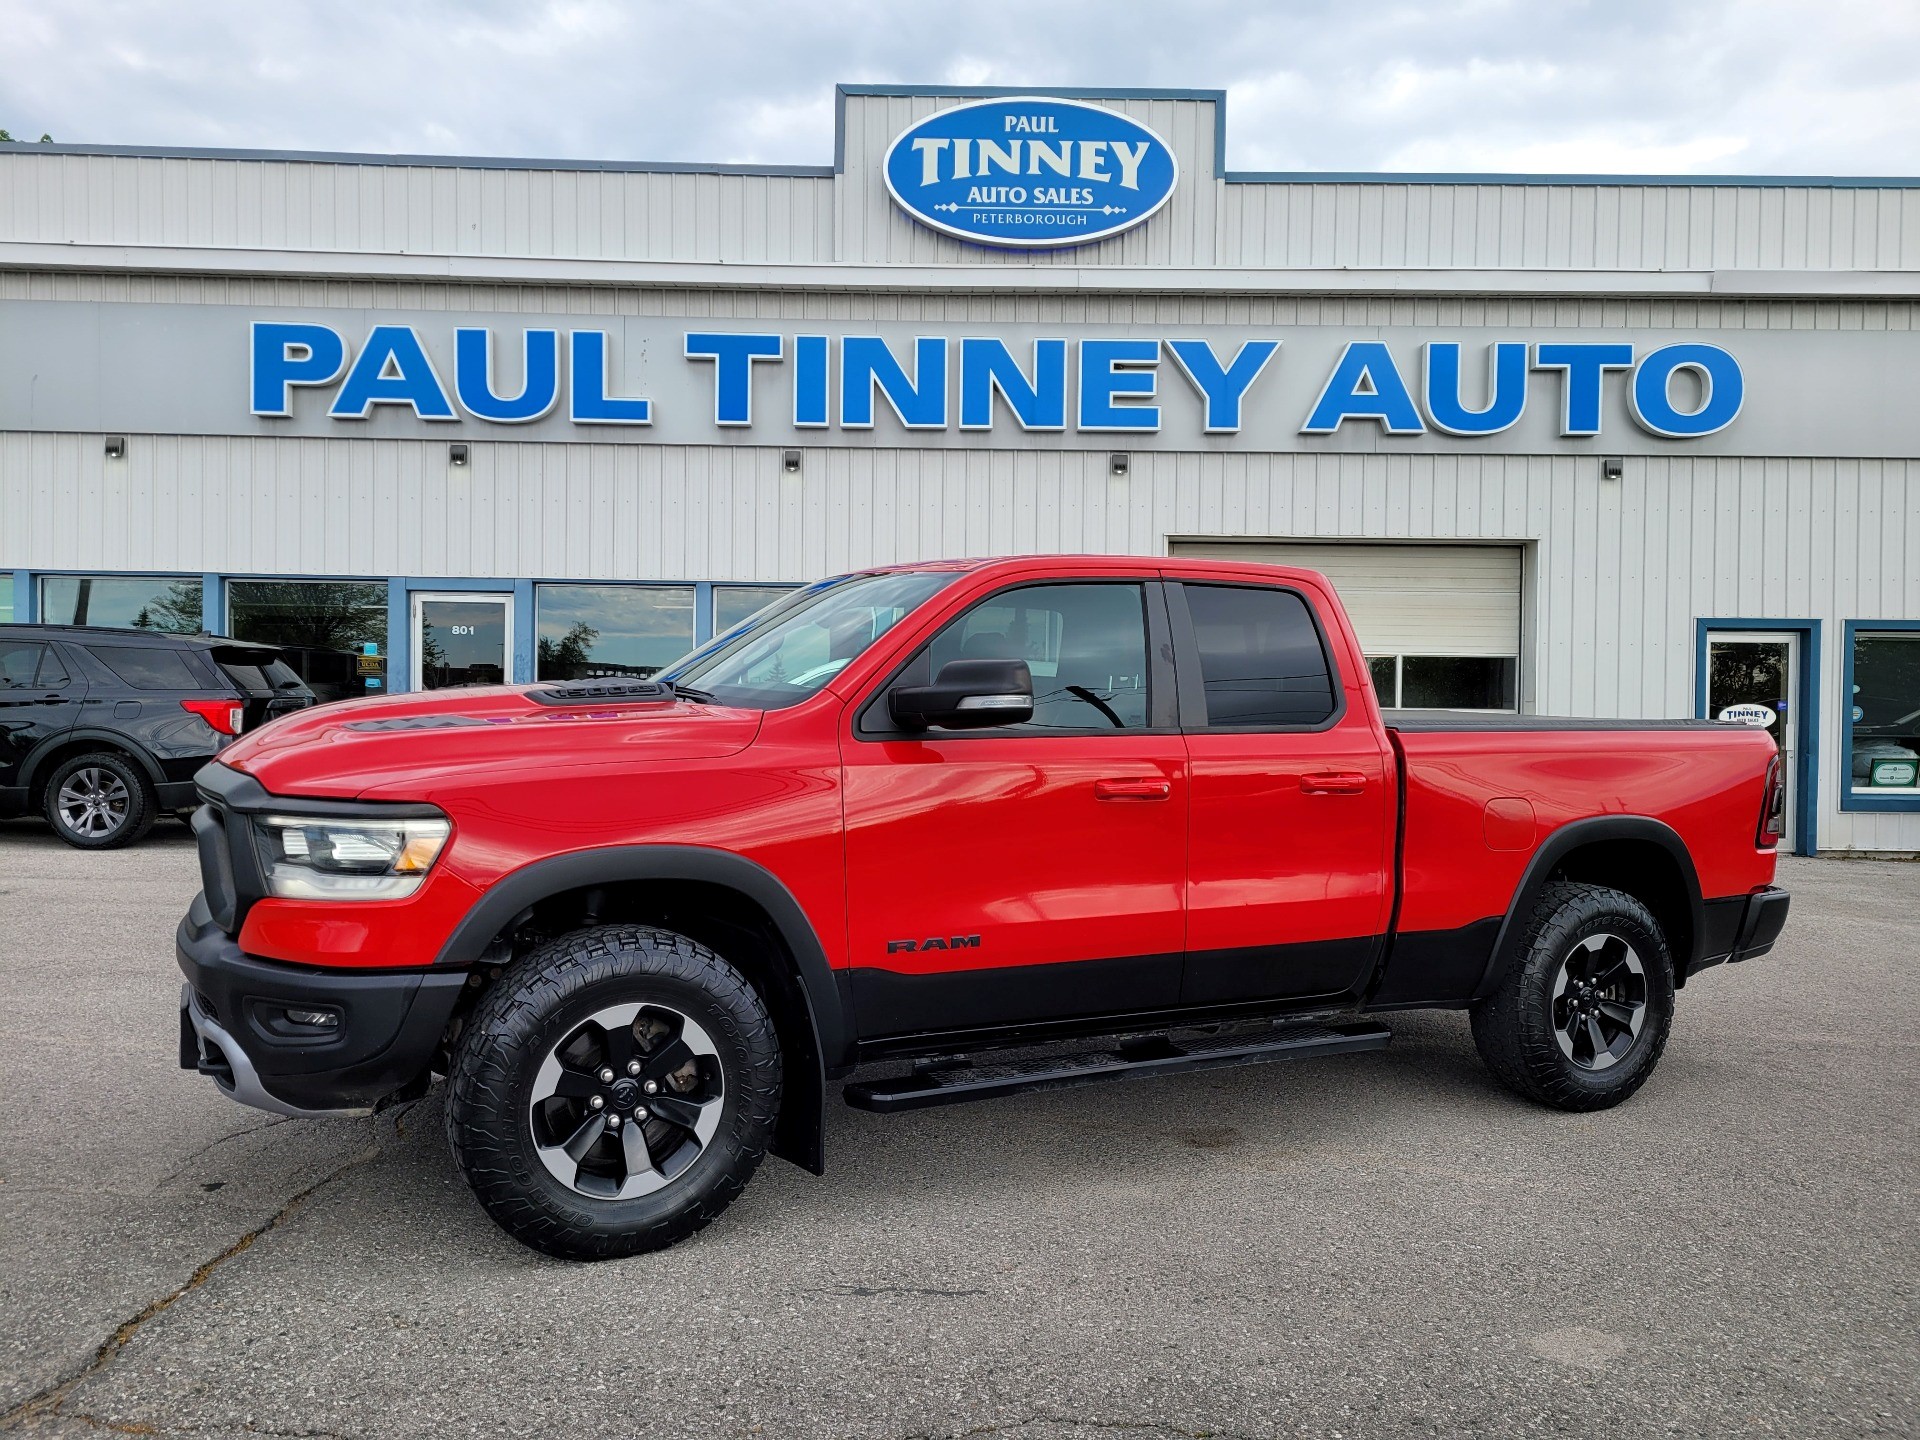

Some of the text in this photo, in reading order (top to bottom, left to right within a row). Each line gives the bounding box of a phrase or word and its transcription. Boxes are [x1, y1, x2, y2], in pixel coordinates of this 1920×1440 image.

[1004, 115, 1059, 133] PAUL
[911, 138, 1151, 191] TINNEY
[967, 187, 1094, 205] AUTO SALES
[973, 213, 1087, 225] PETERBOROUGH
[249, 320, 1746, 438] PAUL TINNEY AUTO
[451, 625, 475, 636] 801
[1727, 710, 1768, 719] TINNEY
[887, 934, 980, 954] RAM
[528, 1186, 594, 1228] OPEN
